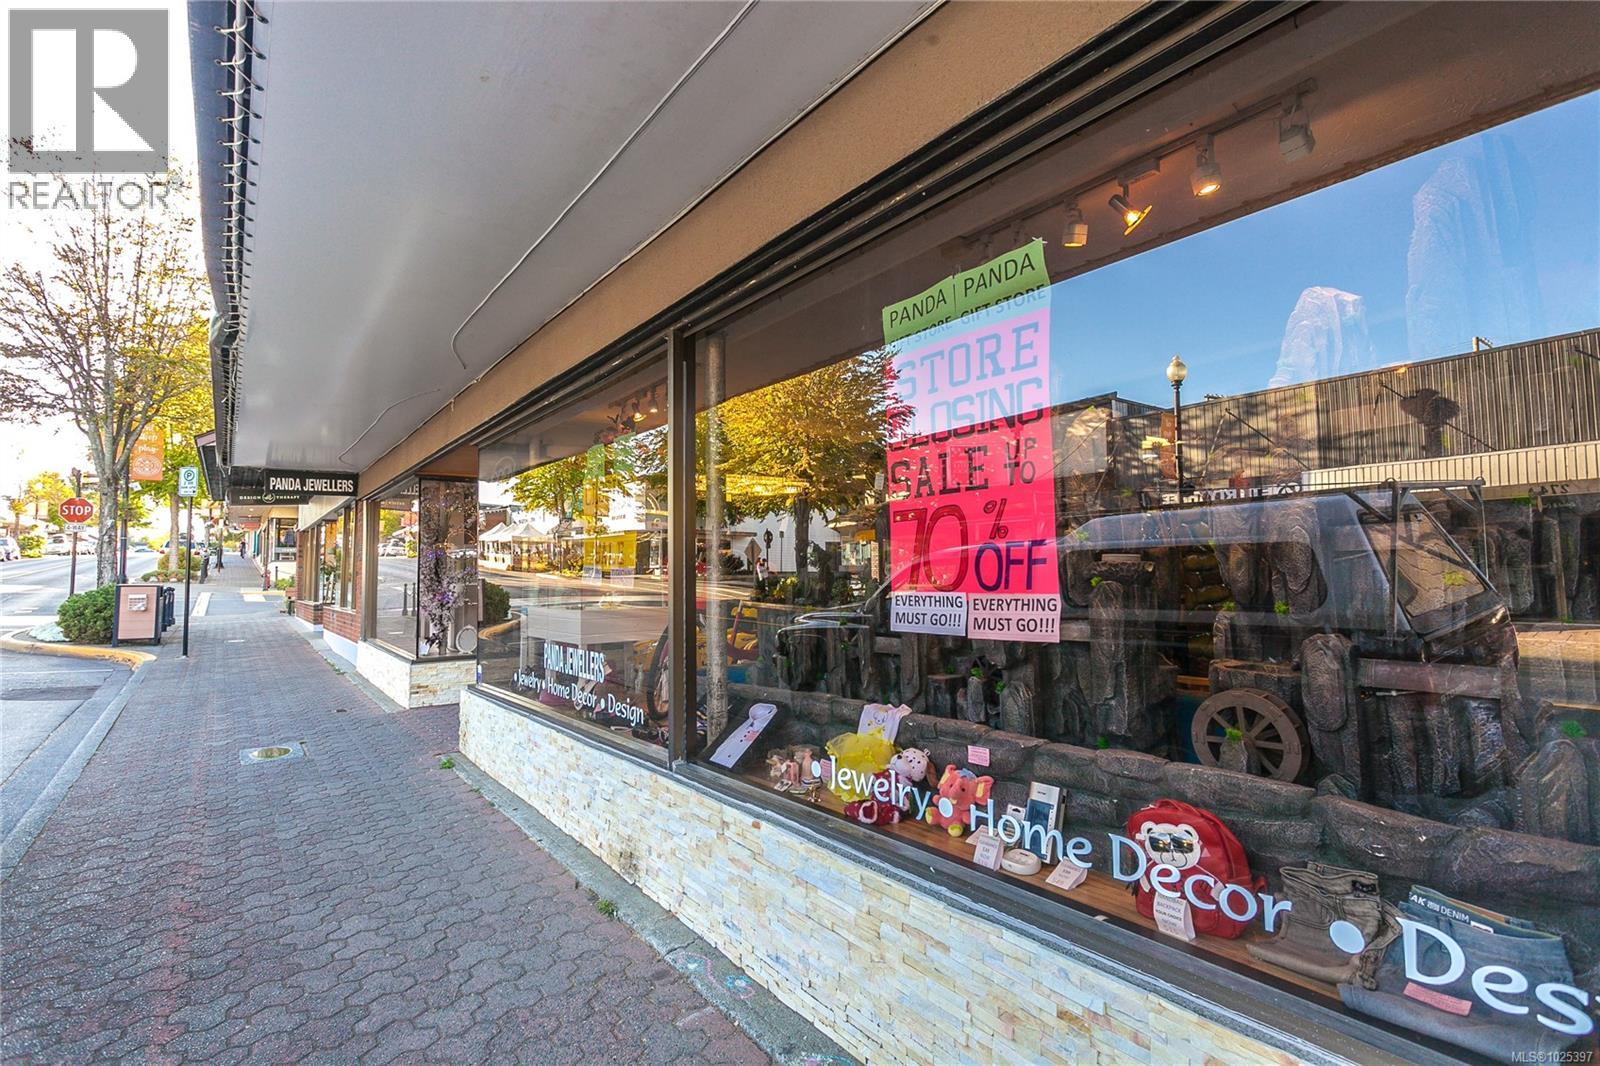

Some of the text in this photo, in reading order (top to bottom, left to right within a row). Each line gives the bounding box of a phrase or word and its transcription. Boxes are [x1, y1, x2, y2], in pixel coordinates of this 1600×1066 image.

[889, 252, 1036, 329] PANDA PANDA
[960, 283, 1048, 326] GIFT STORE
[896, 321, 1040, 401] STORE
[1005, 437, 1037, 461] UP
[269, 477, 354, 493] PANDA JEWELLERS
[890, 445, 989, 500] SALE
[1004, 460, 1036, 486] TO
[61, 505, 92, 515] STOP
[974, 539, 1048, 592] OFF
[894, 594, 963, 609] EVERYTHING
[973, 598, 1058, 612] EVERYTHING
[894, 612, 962, 627] MUST GO!!!
[973, 617, 1056, 633] MUST GO!!!
[543, 642, 605, 684] PANDA JEWELLERS
[517, 668, 645, 727] Jewelry Home Decor Design
[829, 754, 1600, 1036] Jewelry Home Decor Des
[1440, 905, 1470, 923] DENIM
